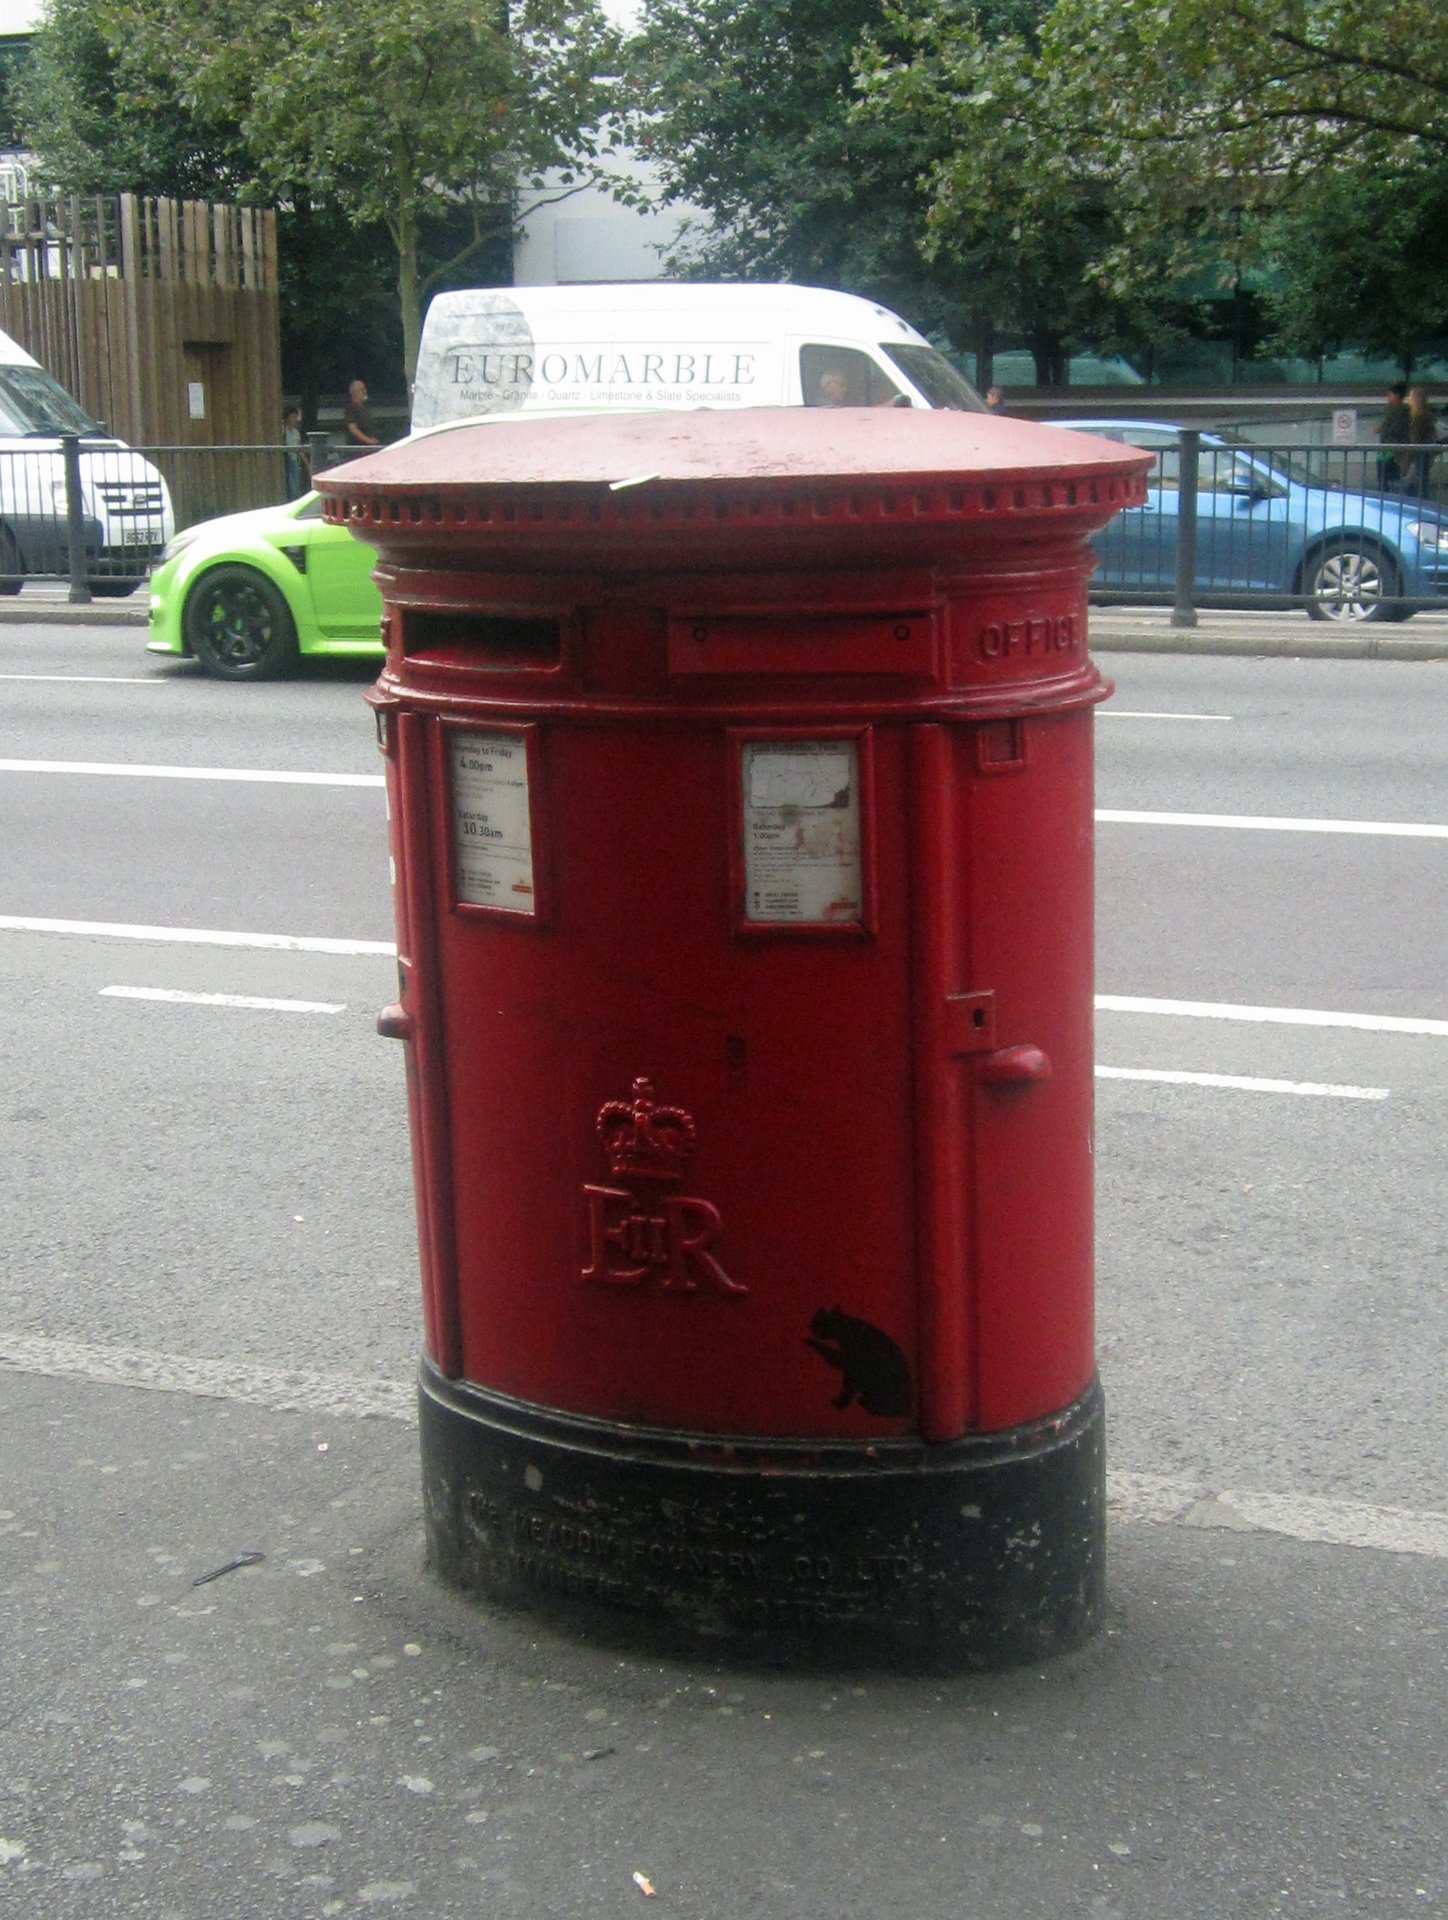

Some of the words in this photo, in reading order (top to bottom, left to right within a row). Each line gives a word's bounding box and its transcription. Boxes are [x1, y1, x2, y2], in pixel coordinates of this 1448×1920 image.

[450, 353, 756, 385] EUROMARBLE
[460, 388, 493, 401] Marble
[502, 388, 538, 401] Granite
[548, 388, 581, 402] Quartz
[590, 388, 644, 401] Limestone
[646, 388, 654, 402] &
[656, 388, 682, 401] Slate
[685, 388, 741, 403] Specialists
[980, 613, 1080, 660] OFFICE
[490, 748, 512, 760] Friday
[459, 758, 493, 773] 4.00pm
[463, 821, 503, 839] 10.30am
[753, 823, 786, 832] Saturday
